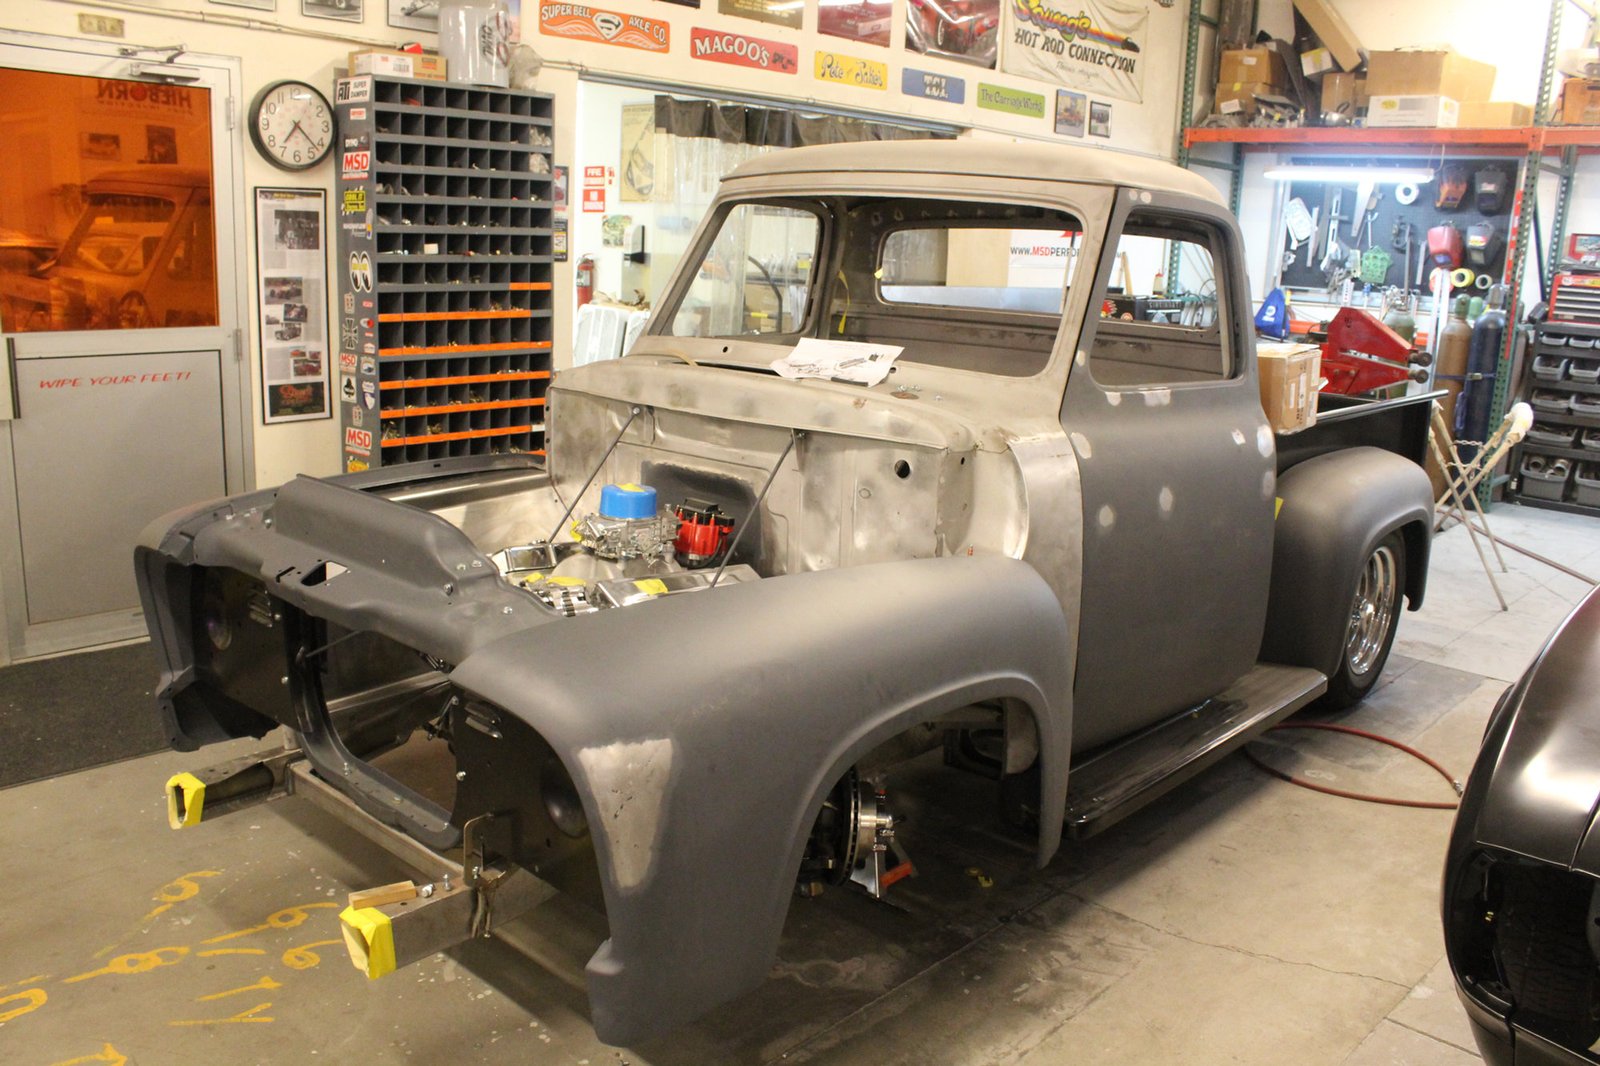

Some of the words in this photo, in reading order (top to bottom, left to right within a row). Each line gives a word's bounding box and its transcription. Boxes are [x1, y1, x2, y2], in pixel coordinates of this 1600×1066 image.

[541, 4, 571, 21] SUPER
[573, 6, 592, 19] BELL
[628, 16, 651, 33] AXLE
[653, 25, 666, 43] CO.
[694, 35, 770, 68] MAGOO'S
[1014, 28, 1040, 48] HOT
[1041, 36, 1065, 55] ROD
[1068, 43, 1136, 74] CONNECTION
[277, 91, 284, 104] 11
[290, 87, 301, 101] 12
[981, 88, 993, 103] The
[266, 101, 276, 115] 10
[316, 104, 324, 118] 2
[262, 117, 270, 131] 9
[321, 120, 330, 133] 3
[268, 134, 276, 148] 8
[317, 137, 325, 149] 4
[279, 145, 287, 158] 7
[293, 150, 302, 163] 6
[307, 147, 316, 160] 5
[344, 153, 368, 171] MSD
[340, 353, 356, 366] MSD
[39, 378, 83, 389] WIPE
[90, 375, 136, 386] YOUR
[140, 371, 191, 383] FEET!
[347, 429, 371, 448] MSD
